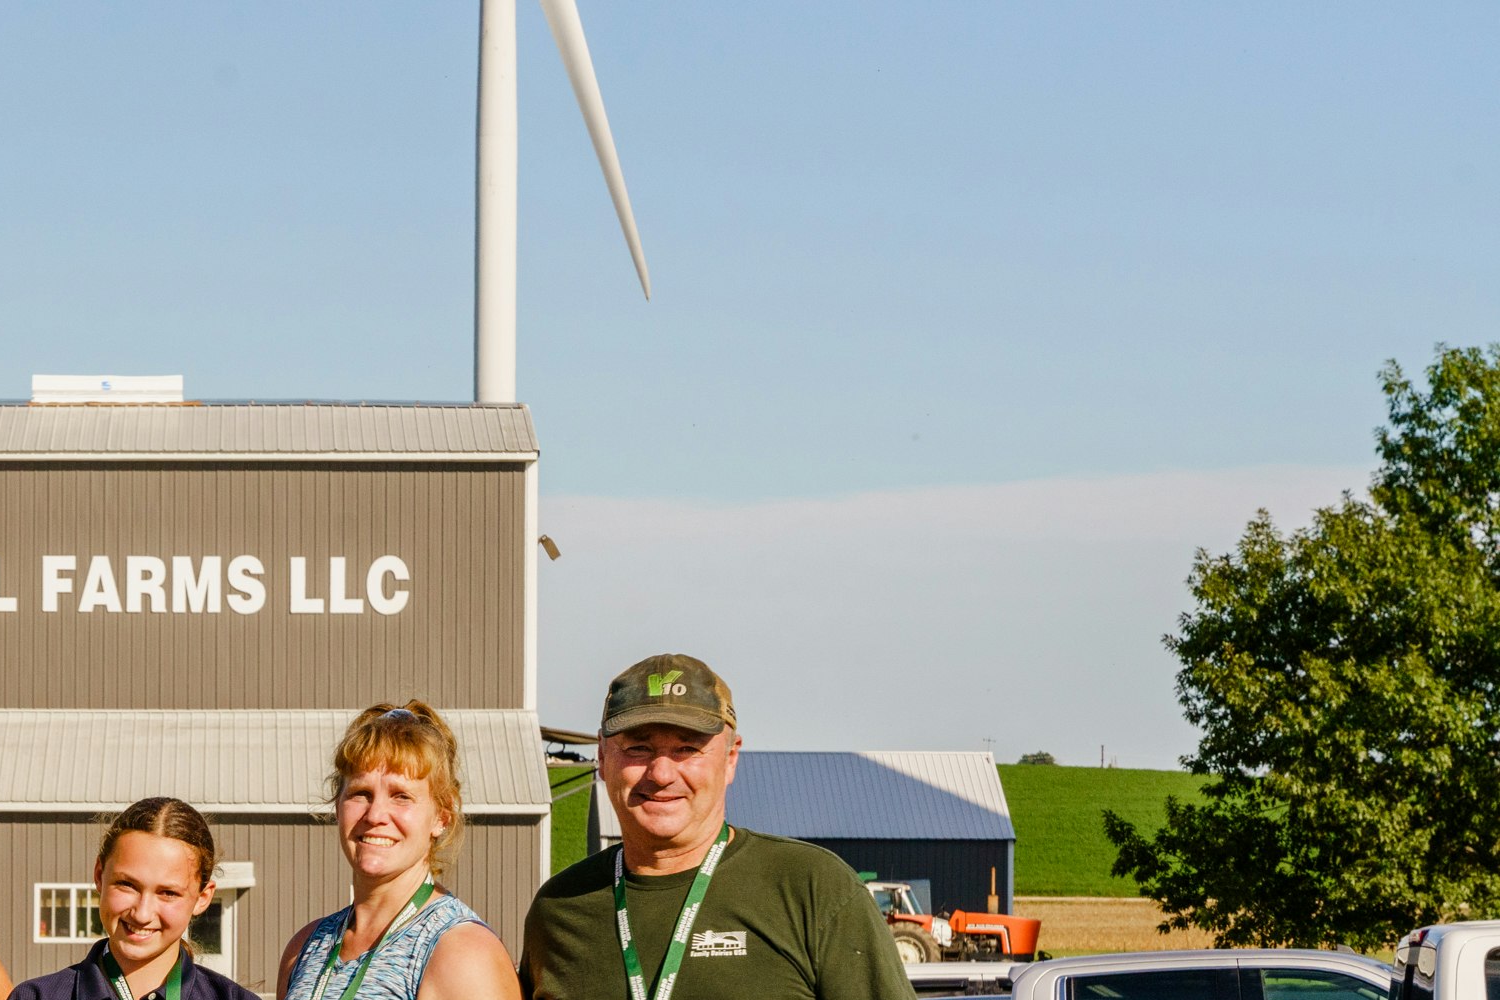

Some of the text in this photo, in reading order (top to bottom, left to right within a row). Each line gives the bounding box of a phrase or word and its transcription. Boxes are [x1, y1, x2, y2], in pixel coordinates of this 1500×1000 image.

[42, 555, 267, 615] FARMS
[290, 555, 412, 615] LLC
[690, 950, 710, 958] Family
[710, 949, 733, 957] Dairies
